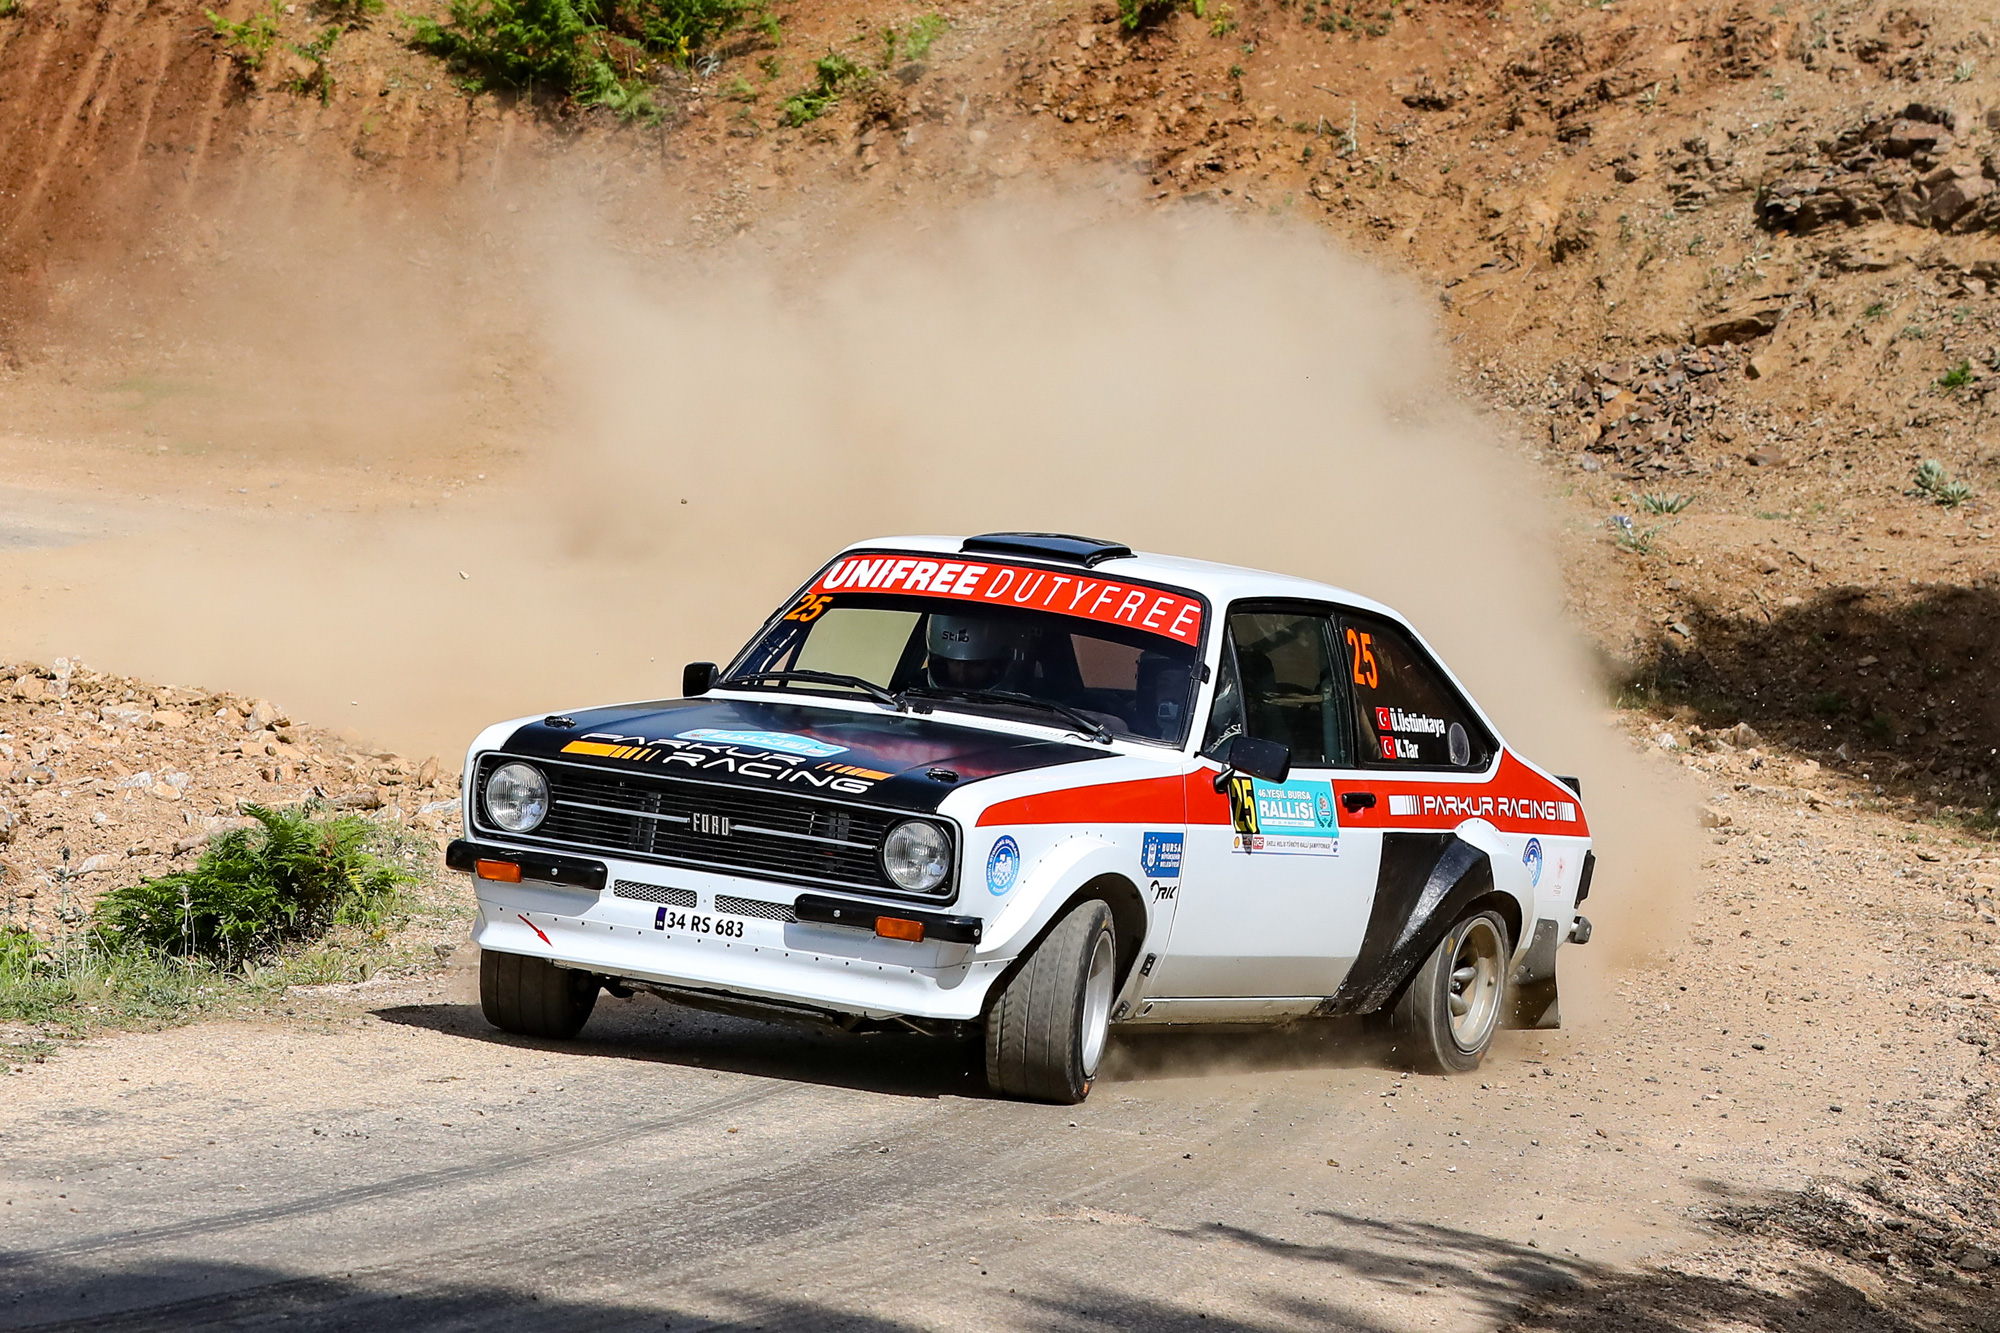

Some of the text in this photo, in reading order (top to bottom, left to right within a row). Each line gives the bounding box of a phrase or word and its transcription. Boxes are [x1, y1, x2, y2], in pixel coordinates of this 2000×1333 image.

[783, 594, 834, 623] 25
[822, 558, 1200, 637] UNIFREE DUTYFREE
[1347, 628, 1378, 689] 25
[1389, 707, 1446, 738] Ü.Üstünkaya
[580, 732, 807, 766] PARKUR
[1394, 738, 1419, 759] K.Tar
[663, 751, 875, 794] RACING
[1231, 777, 1257, 833] 25
[1287, 790, 1312, 800] BURSA
[1423, 795, 1557, 821] PARKUR RACING
[693, 813, 730, 836] FORD
[1161, 842, 1182, 853] BURSA
[667, 911, 744, 938] 34 RS 683
